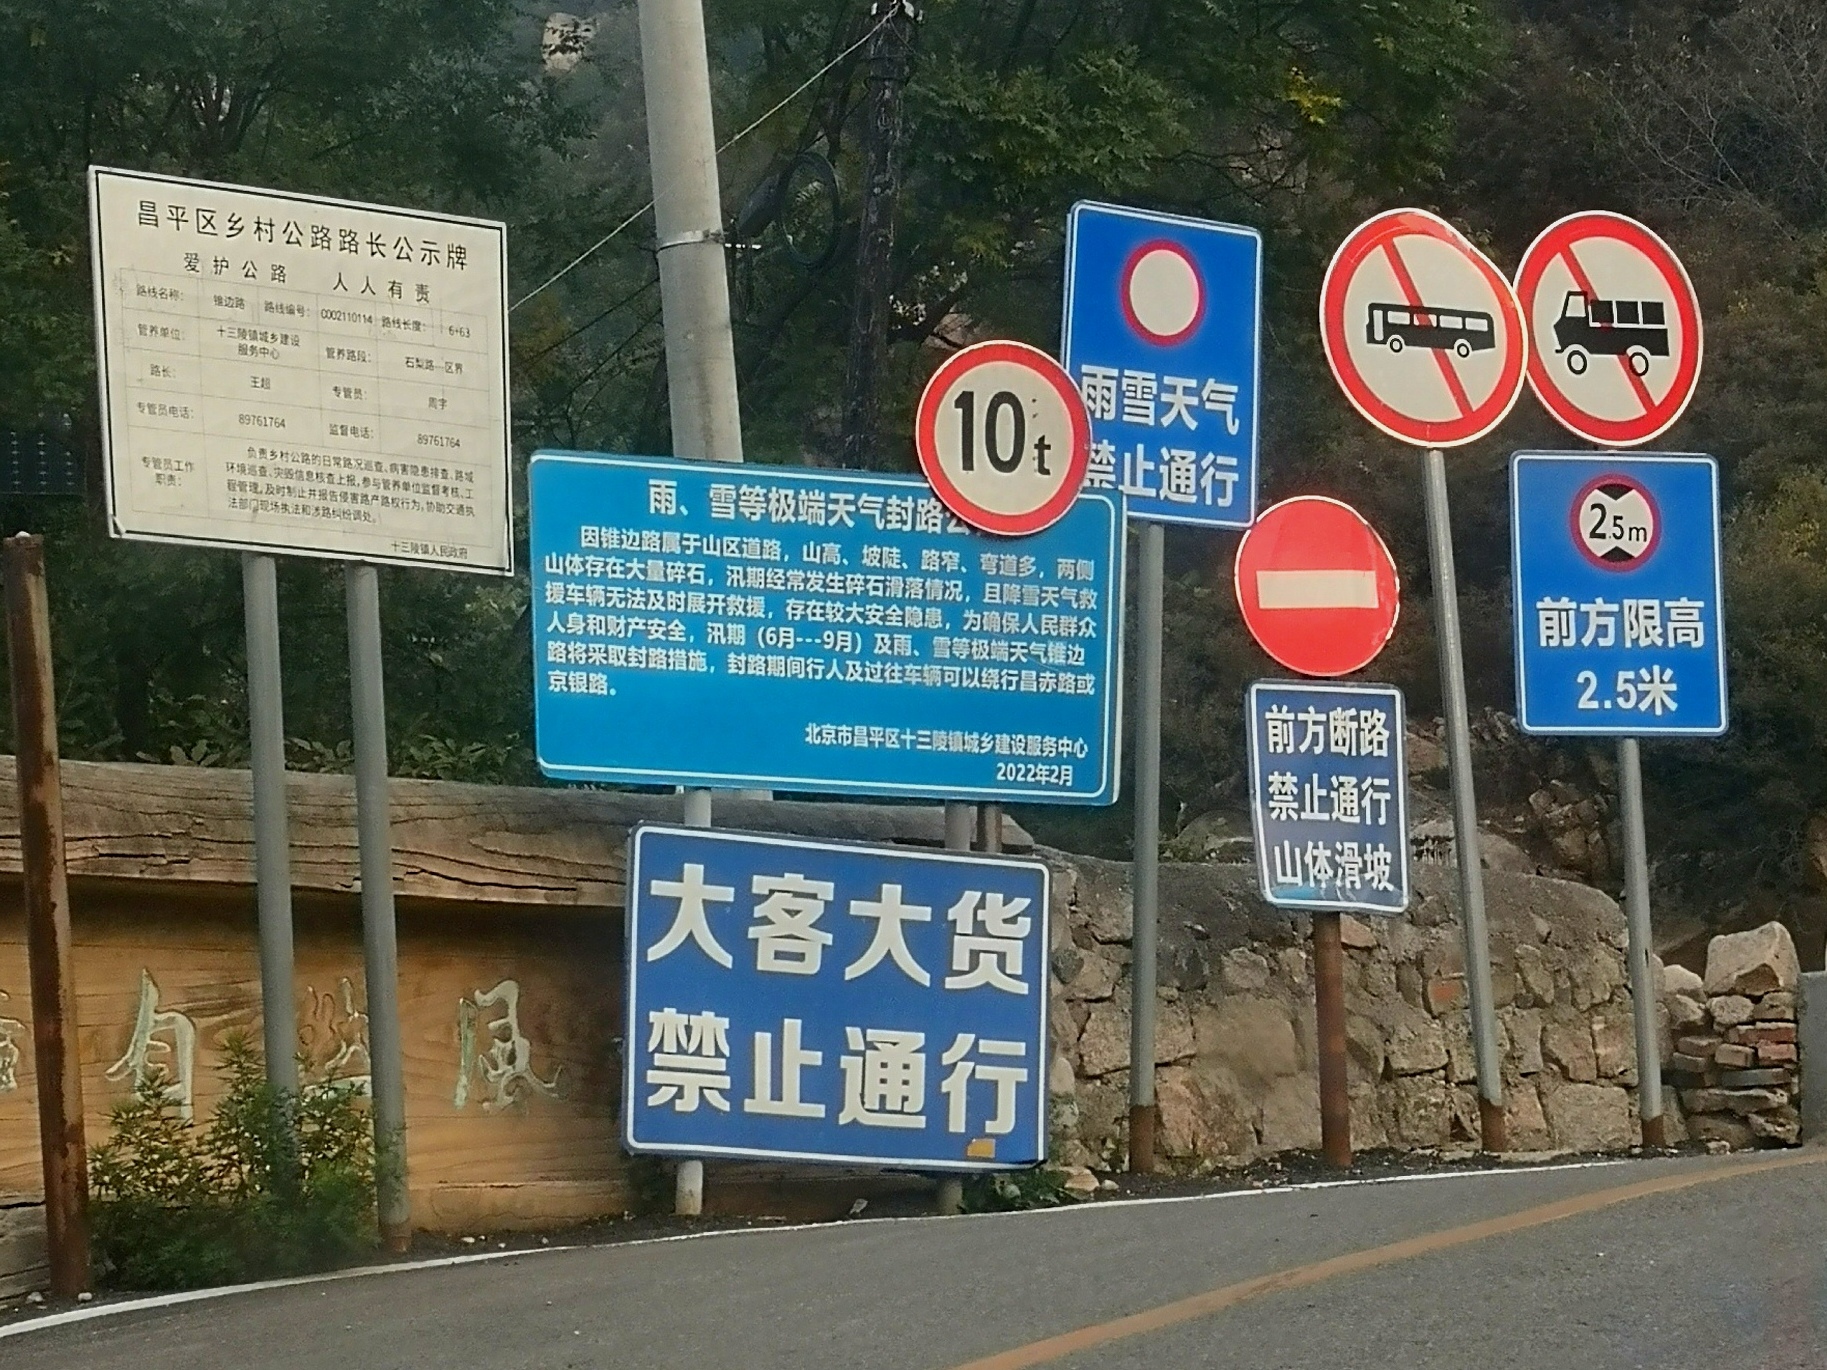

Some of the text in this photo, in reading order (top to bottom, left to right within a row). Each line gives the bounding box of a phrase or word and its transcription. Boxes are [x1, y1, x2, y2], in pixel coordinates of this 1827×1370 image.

[137, 200, 468, 271] 昌平区乡村公路路长公示牌
[184, 252, 431, 304] 爱护公路 人人有责
[1081, 364, 1240, 436] 雨雪天气
[238, 413, 286, 429] 89761764
[417, 433, 461, 449] 89761764
[953, 389, 1053, 477] 10t
[1082, 439, 1239, 508] 禁止通行
[1536, 597, 1705, 649] 前方限高
[547, 670, 617, 696] 京银路。
[1576, 665, 1679, 717] 2.5米
[804, 721, 1089, 760] 北京市昌平区十三陵镇城乡建设服务中心
[1264, 704, 1391, 758] 前方断路
[996, 762, 1074, 787] 2022年2月
[1268, 771, 1392, 826] 禁止通行
[1273, 838, 1394, 892] 山体滑坡
[646, 862, 1032, 995] 大客大货
[646, 1007, 1029, 1134] 禁止通行
